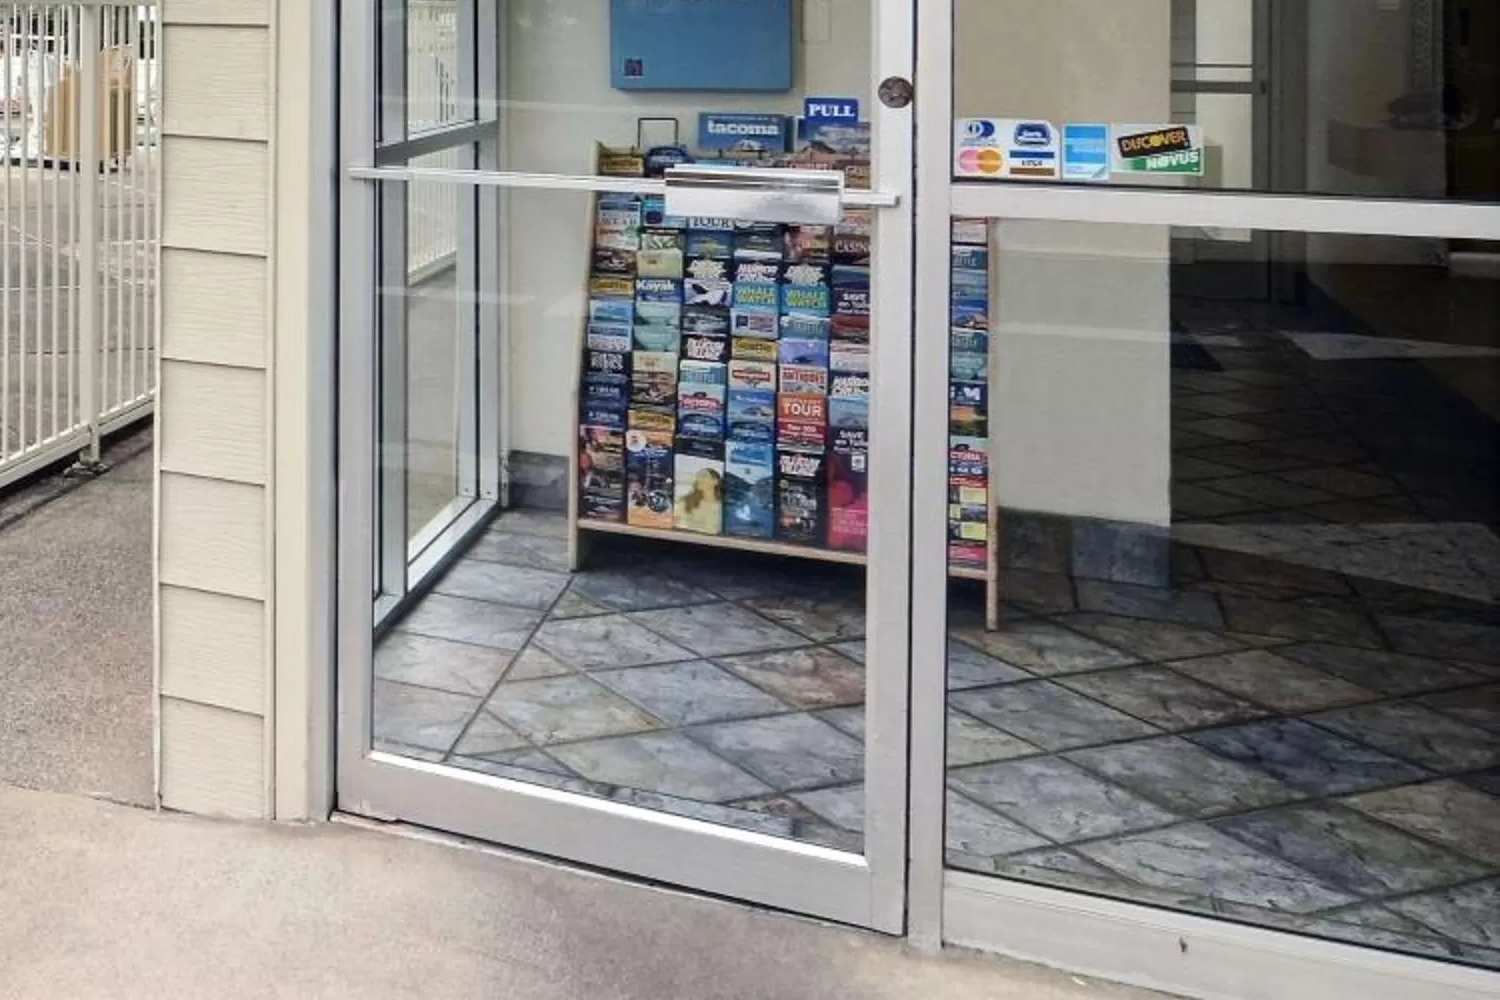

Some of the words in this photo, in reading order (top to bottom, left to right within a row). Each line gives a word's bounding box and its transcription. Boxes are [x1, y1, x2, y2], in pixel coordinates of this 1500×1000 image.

[808, 103, 856, 117] PULL
[707, 119, 780, 136] tacoma
[1121, 130, 1187, 151] DISCOVER
[1146, 151, 1199, 170] NOVUS
[636, 279, 676, 293] Kayak
[783, 402, 822, 417] TOUR
